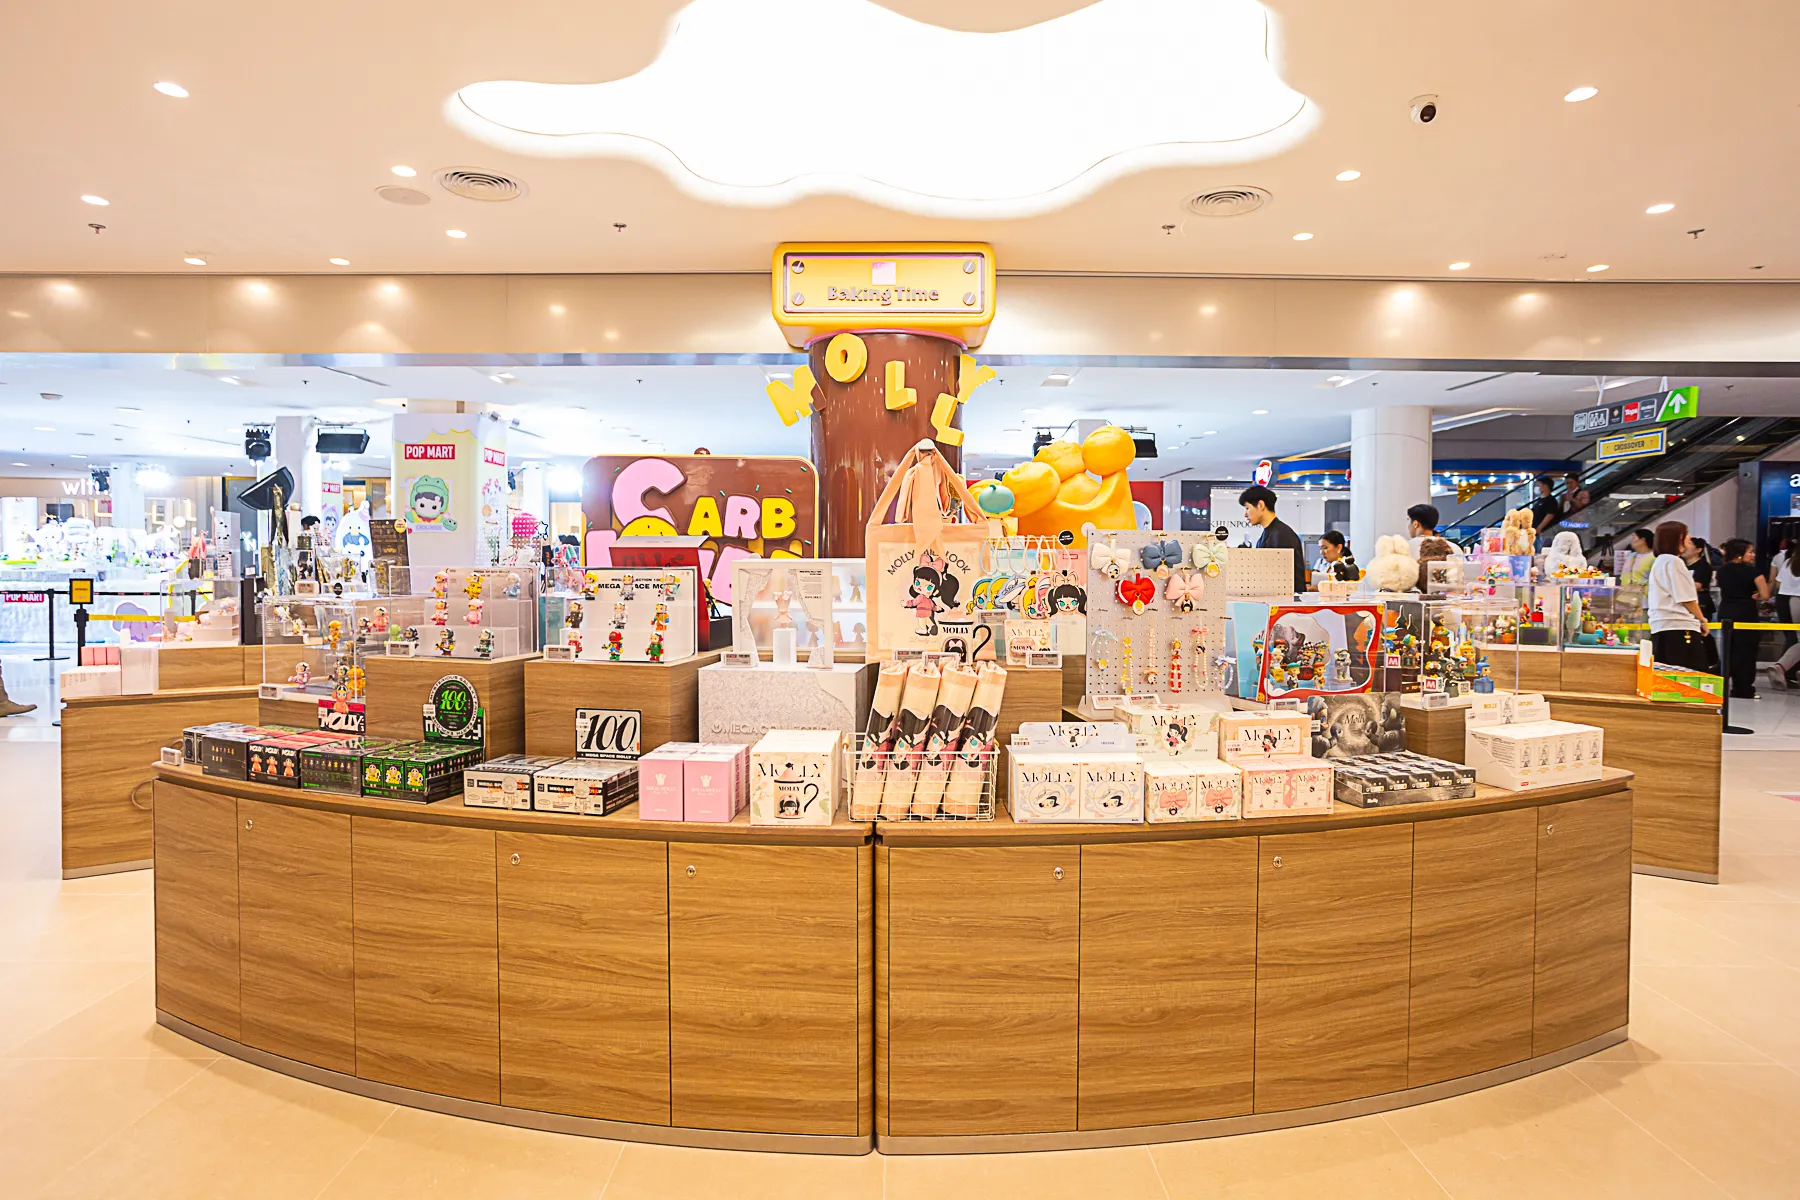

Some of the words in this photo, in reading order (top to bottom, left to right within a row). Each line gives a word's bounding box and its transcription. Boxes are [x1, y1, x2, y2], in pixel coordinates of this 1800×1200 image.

[827, 286, 892, 306] Baking
[894, 286, 939, 302] Time
[405, 445, 426, 459] POP
[426, 445, 454, 459] MART
[1613, 440, 1645, 452] CROSSOVER
[1210, 520, 1262, 529] KHUNPOO
[887, 549, 915, 575] MOLLY
[942, 626, 970, 634] MOLLY
[440, 689, 467, 711] 100
[321, 711, 364, 732] MOLLY
[1151, 714, 1200, 727] MLY
[723, 723, 759, 736] MEGA
[1048, 724, 1100, 737] MLY
[1244, 728, 1297, 742] MLY
[758, 763, 826, 778] MLY
[778, 785, 801, 793] MOLLY
